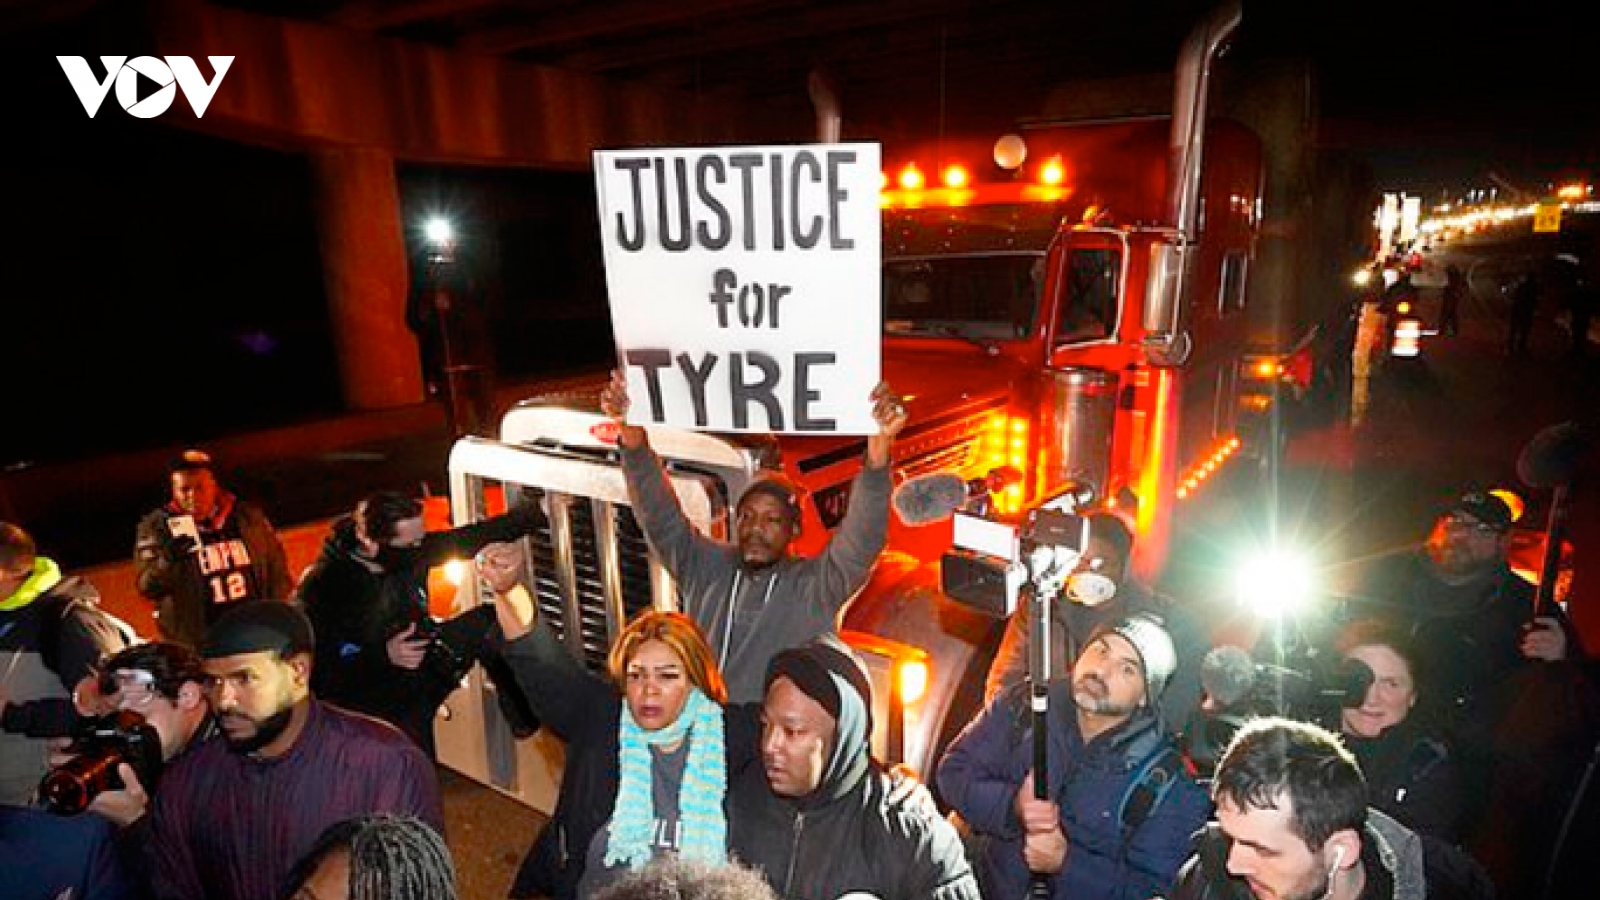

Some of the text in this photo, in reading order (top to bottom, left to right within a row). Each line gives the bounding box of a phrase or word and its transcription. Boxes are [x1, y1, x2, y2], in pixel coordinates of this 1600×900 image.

[614, 150, 857, 252] JUSTICE
[709, 267, 792, 329] for
[627, 348, 837, 431] TYRE
[211, 572, 247, 603] 12
